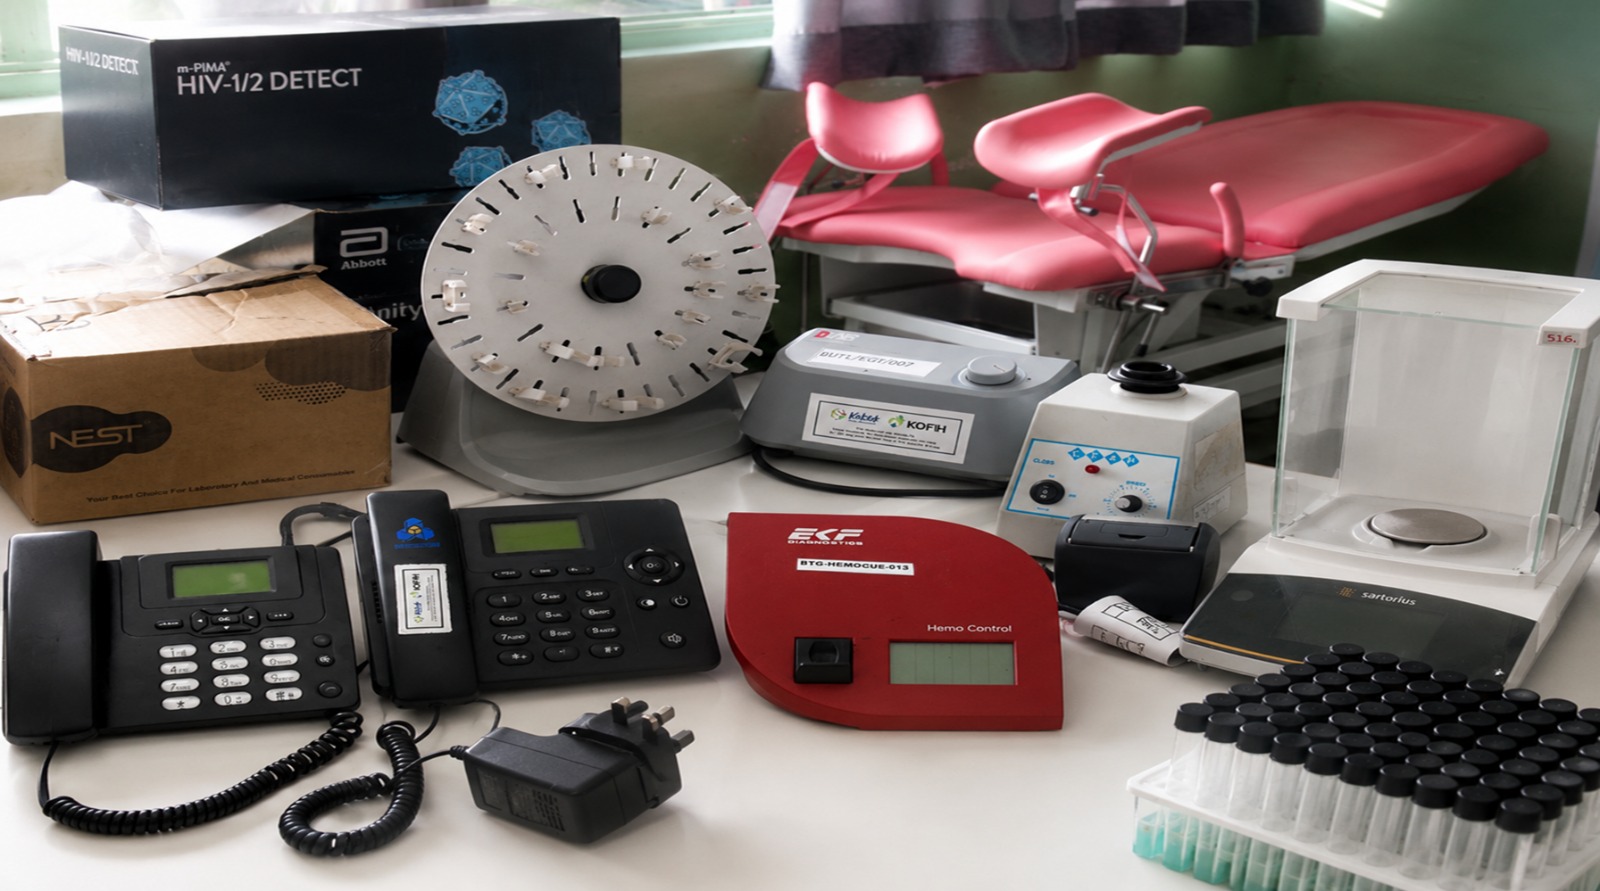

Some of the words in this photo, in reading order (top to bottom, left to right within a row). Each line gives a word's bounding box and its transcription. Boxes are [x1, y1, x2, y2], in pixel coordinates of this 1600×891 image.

[177, 72, 264, 95] HIV-1/2
[270, 68, 363, 91] DETECT
[340, 258, 387, 270] Abbott
[369, 302, 422, 321] nity
[906, 420, 947, 433] KOFIH
[50, 424, 143, 449] NEST
[135, 490, 168, 498] Choice
[188, 482, 239, 492] Laboratory
[261, 475, 295, 483] Medical
[787, 527, 864, 540] EKF
[1361, 592, 1416, 605] sartorius
[927, 624, 964, 632] Hemo
[967, 624, 1012, 632] Control
